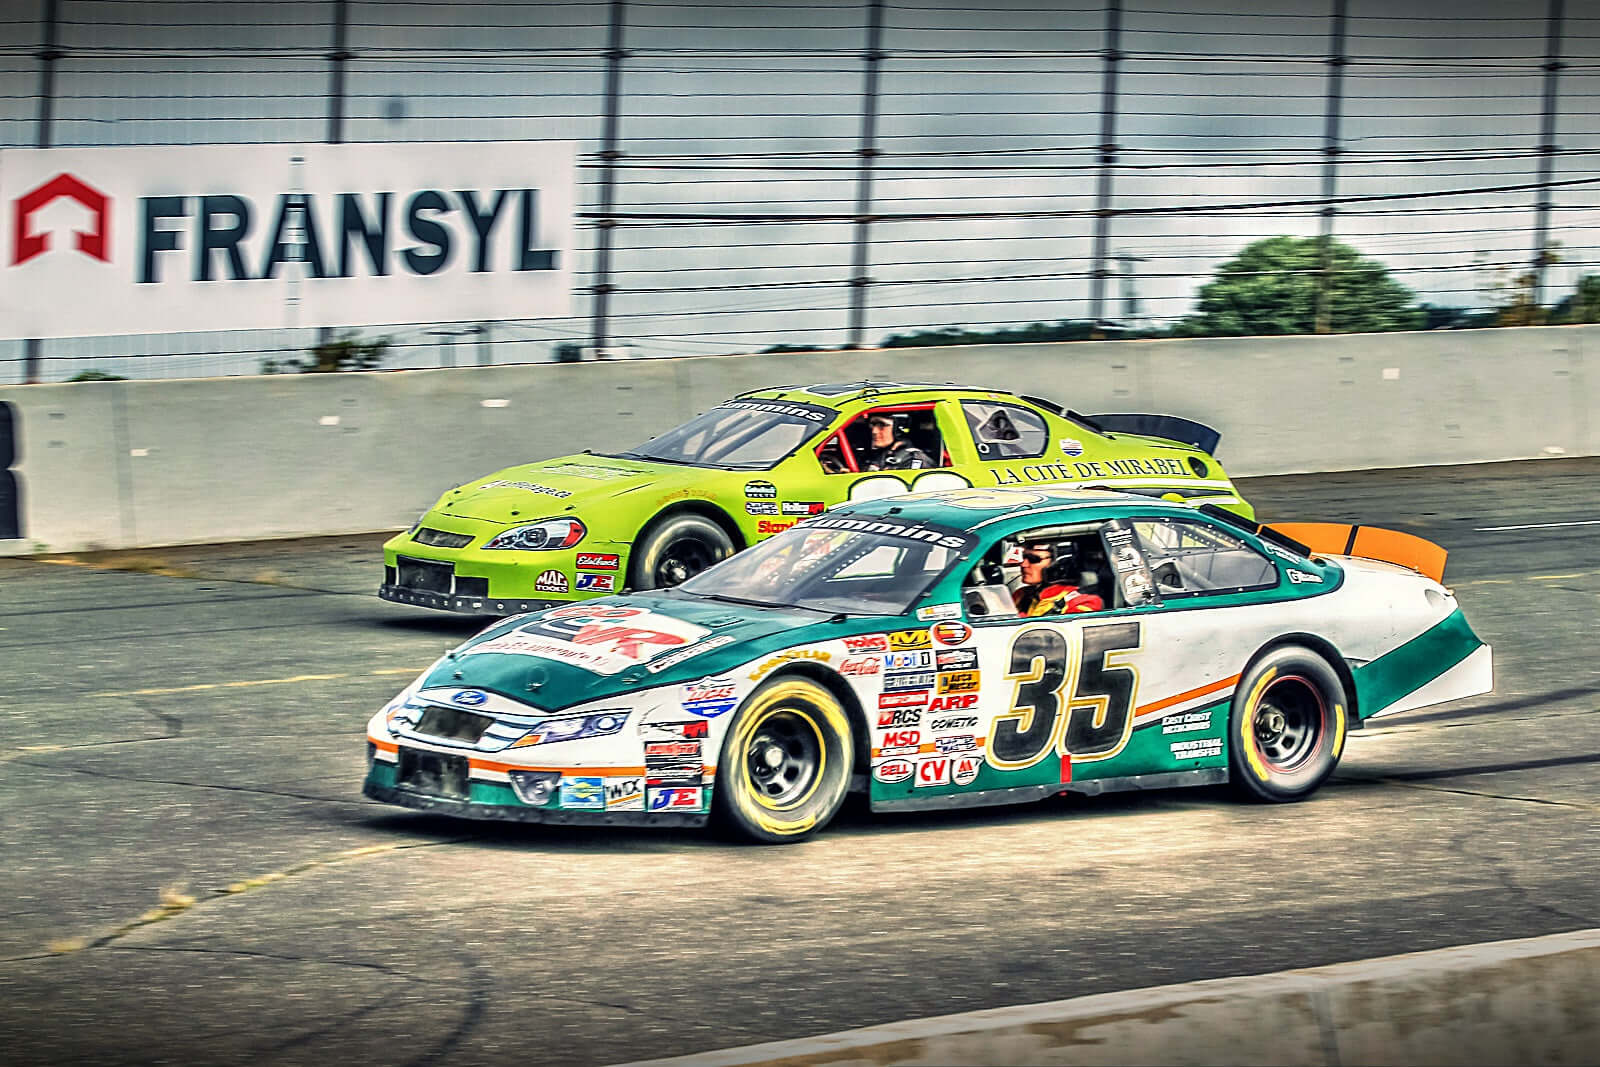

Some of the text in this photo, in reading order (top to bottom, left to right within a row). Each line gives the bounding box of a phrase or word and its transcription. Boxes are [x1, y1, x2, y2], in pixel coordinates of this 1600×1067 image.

[139, 188, 560, 283] FRANSYL
[990, 467, 1022, 485] LA
[1073, 462, 1106, 478] DE
[1104, 457, 1191, 476] MIRABEL
[536, 584, 568, 593] TOOLS
[575, 574, 613, 589] JE
[928, 695, 979, 711] ARP
[988, 621, 1142, 768] 35
[883, 731, 921, 747] MSD
[920, 760, 946, 781] CV
[652, 788, 697, 810] JE
